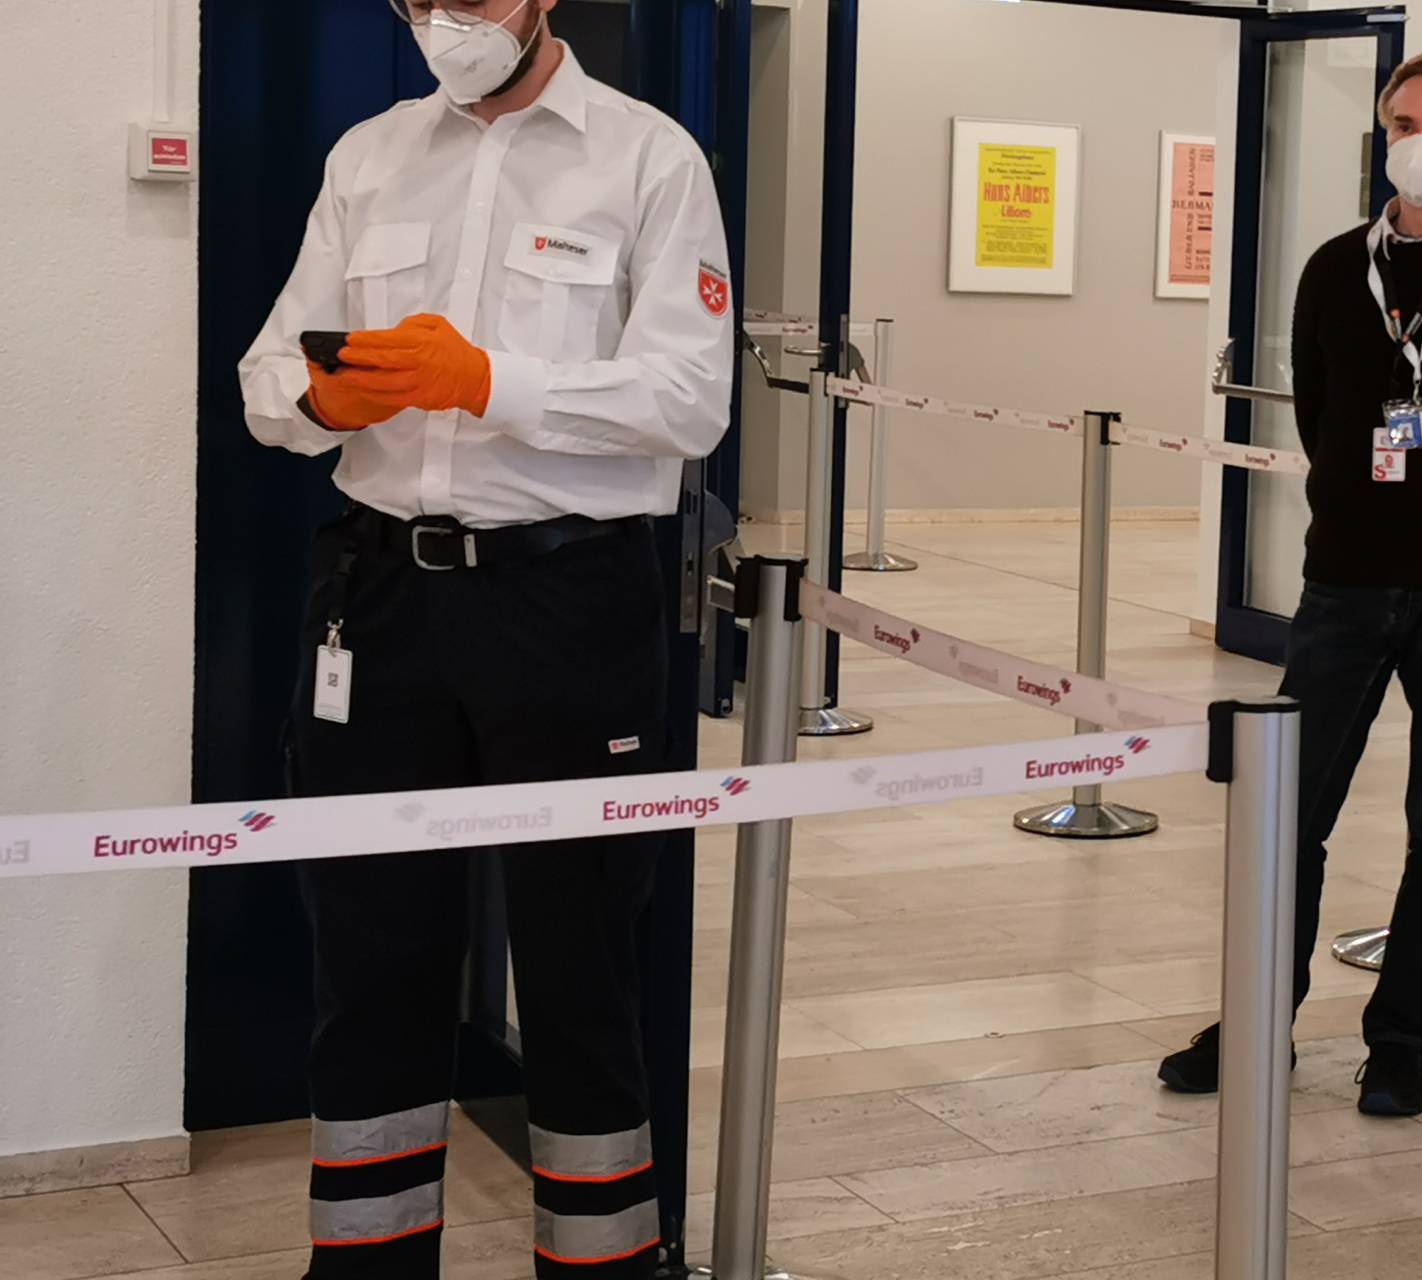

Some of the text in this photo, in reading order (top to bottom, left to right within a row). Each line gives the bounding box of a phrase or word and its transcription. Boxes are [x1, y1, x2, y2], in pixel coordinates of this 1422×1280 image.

[547, 238, 589, 256] Malteser
[874, 624, 911, 654] Eurowings
[1017, 675, 1061, 706] Eurowings
[1025, 753, 1125, 780] Eurowings
[602, 796, 720, 822] Eurowings
[93, 830, 238, 858] Eurowings
